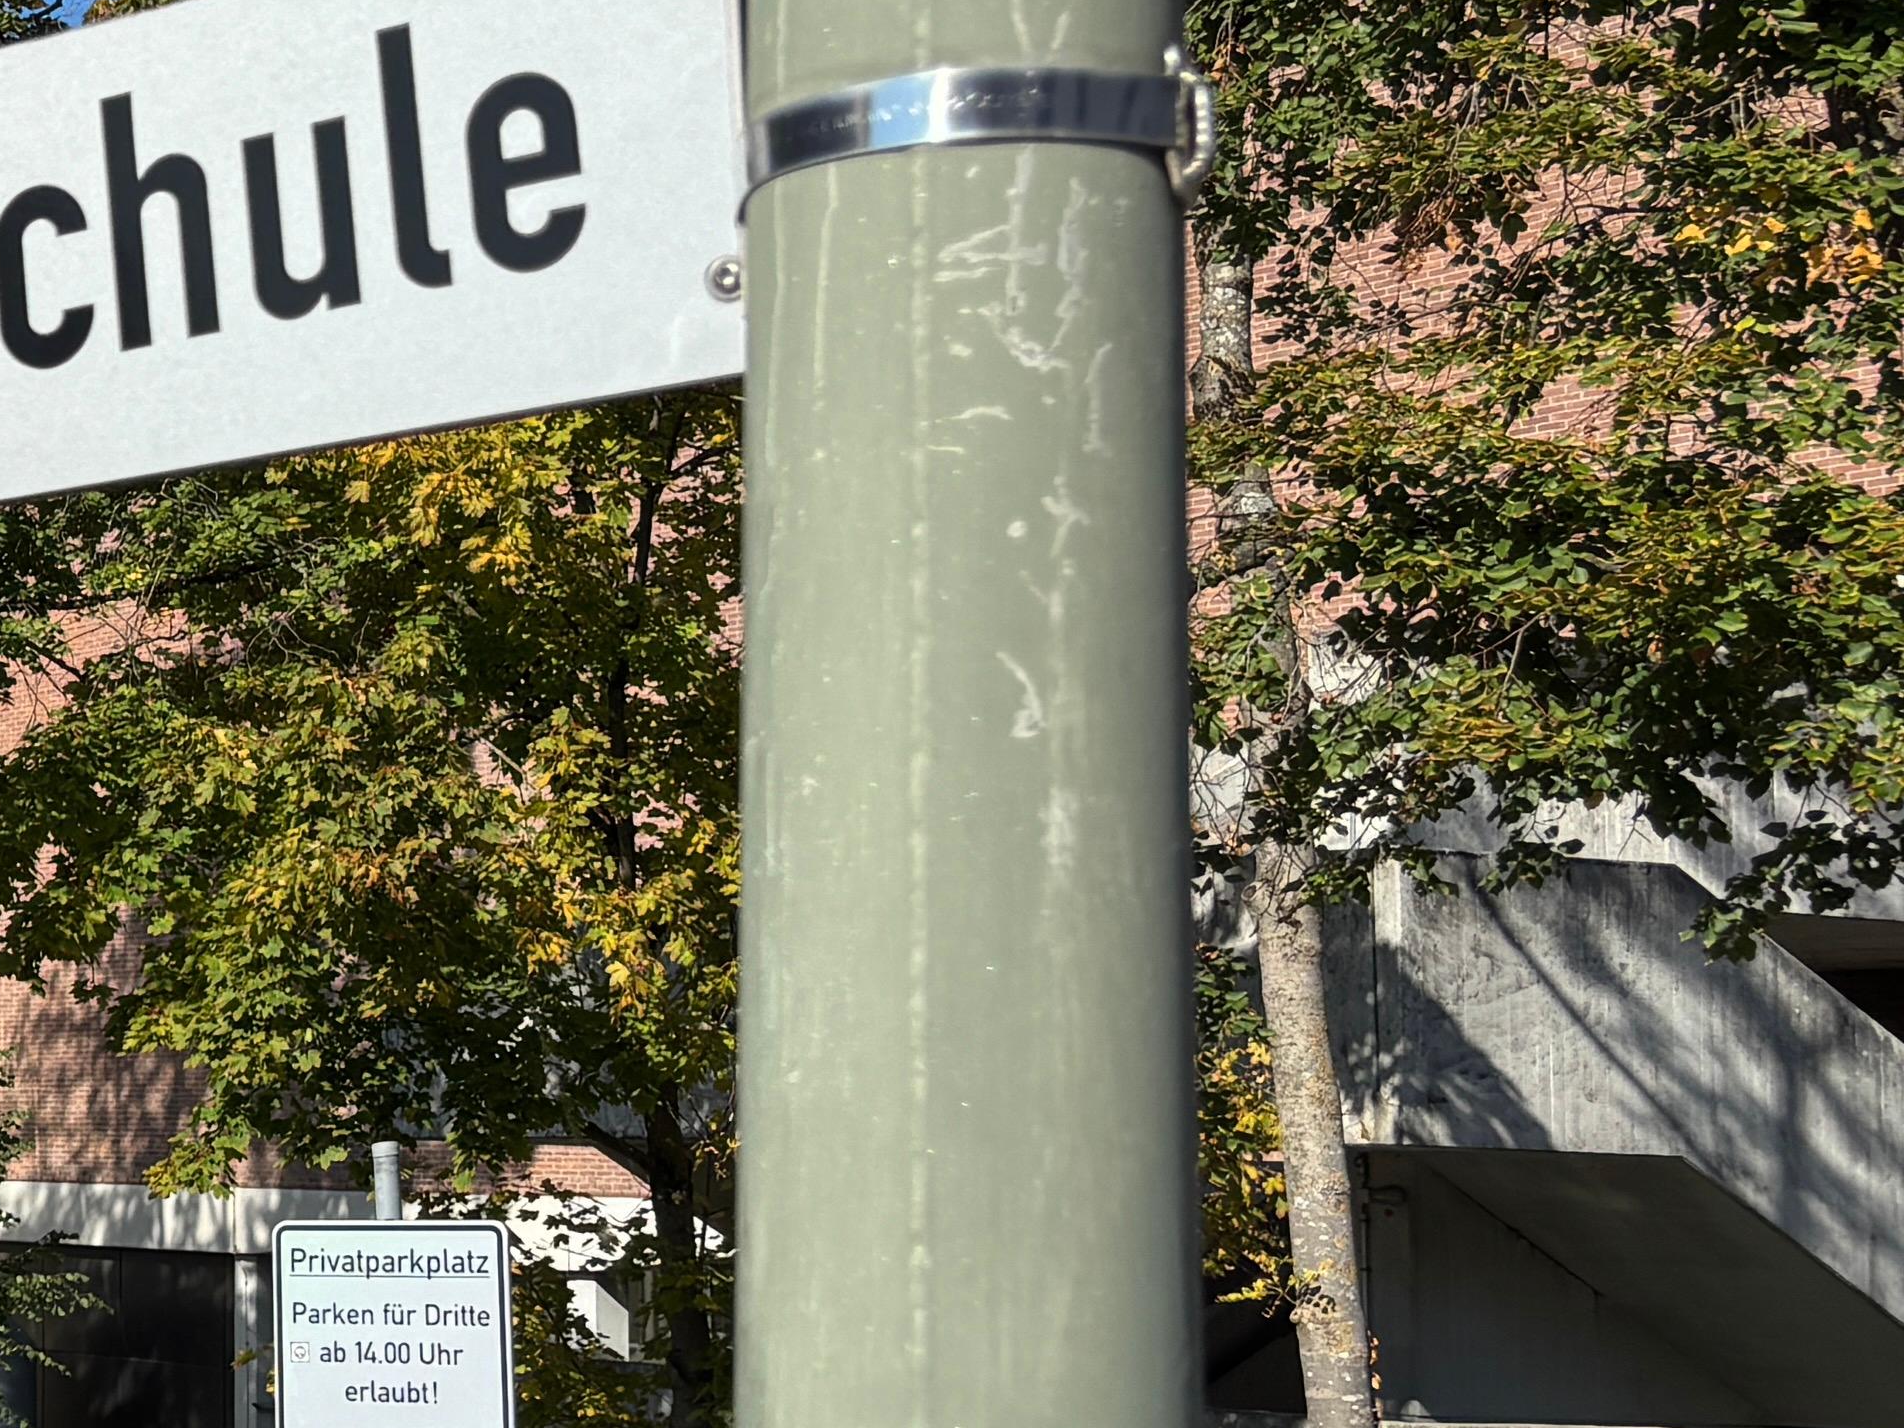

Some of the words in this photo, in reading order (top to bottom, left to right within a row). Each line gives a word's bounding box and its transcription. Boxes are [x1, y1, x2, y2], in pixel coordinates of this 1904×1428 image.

[290, 1247, 490, 1280] Privatparkplatz
[292, 1301, 374, 1326] Parken
[383, 1302, 417, 1327] für
[425, 1303, 491, 1327] Dritte
[319, 1340, 346, 1363] ab
[355, 1341, 411, 1365] 14.00
[419, 1342, 464, 1366] Uhr
[344, 1380, 438, 1404] erlaubt!
